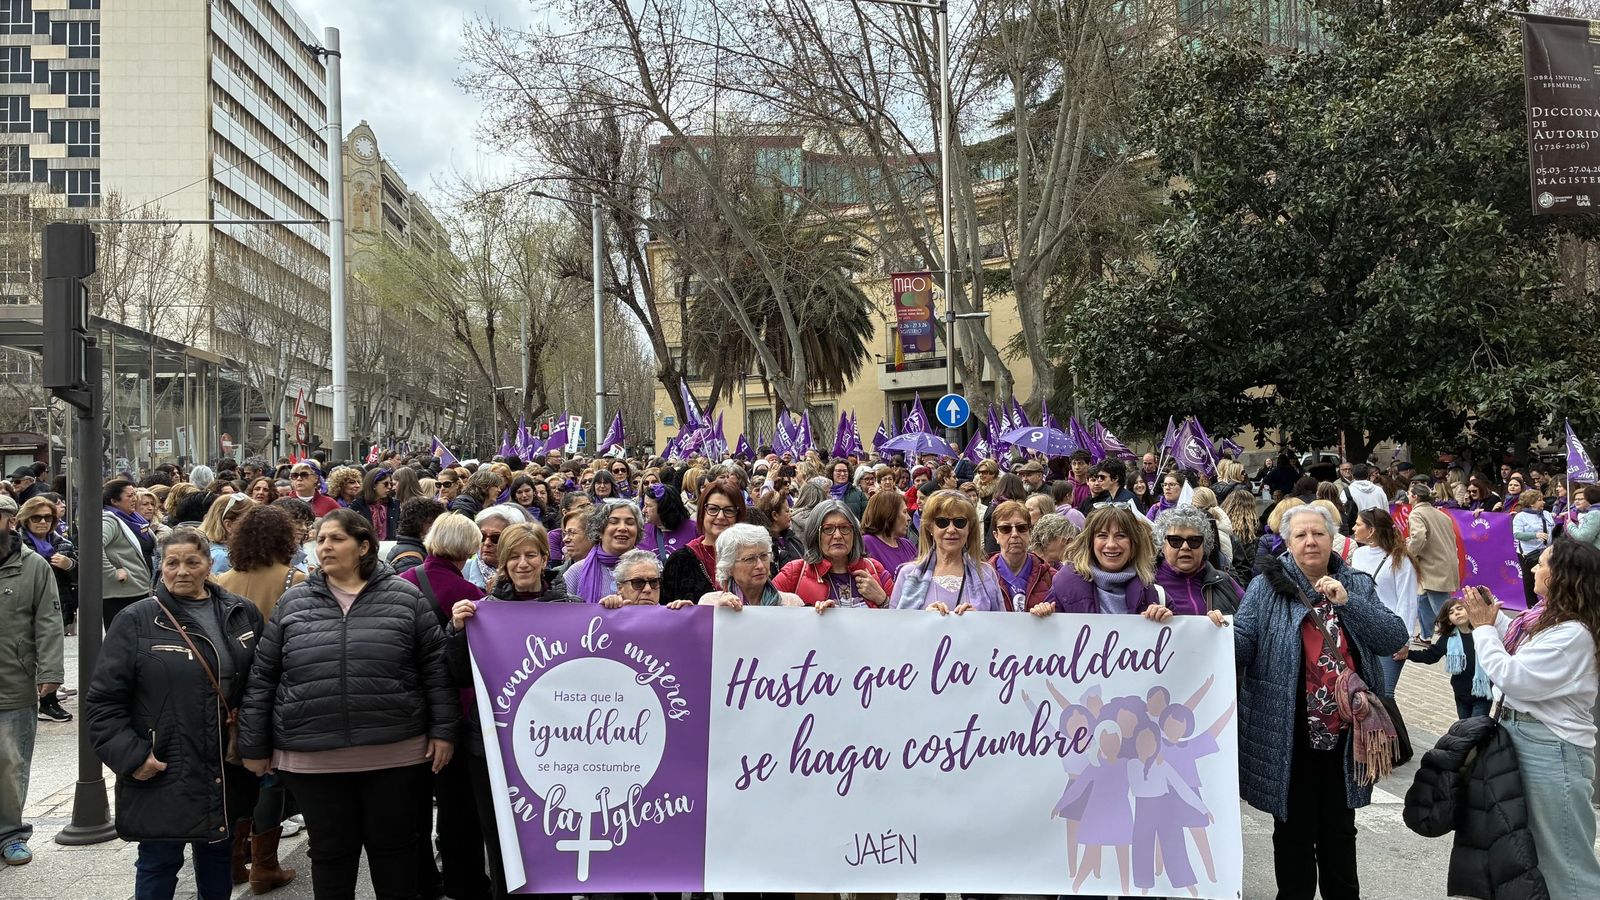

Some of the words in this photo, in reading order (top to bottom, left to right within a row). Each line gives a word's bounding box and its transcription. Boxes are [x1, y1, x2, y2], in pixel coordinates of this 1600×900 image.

[1532, 120, 1548, 128] DE
[1534, 141, 1590, 152] (1726-2026)
[1536, 166, 1560, 174] 05.03
[894, 277, 926, 292] MAO
[580, 616, 612, 652] de
[624, 642, 690, 722] mujeres
[724, 649, 842, 710] Hasta
[853, 660, 919, 708] que
[930, 635, 978, 695] la
[988, 624, 1175, 704] igualdad
[554, 690, 588, 702] Hasta
[590, 693, 612, 704] que
[614, 691, 624, 702] la
[529, 708, 651, 758] igualdad
[734, 747, 778, 791] se
[789, 712, 891, 797] haga
[902, 700, 1094, 772] costumbre
[538, 764, 550, 772] se
[554, 762, 579, 774] haga
[583, 762, 641, 772] costumbre
[543, 784, 582, 836] la
[595, 783, 695, 846] Iglesia
[844, 829, 918, 866] JAÉN
